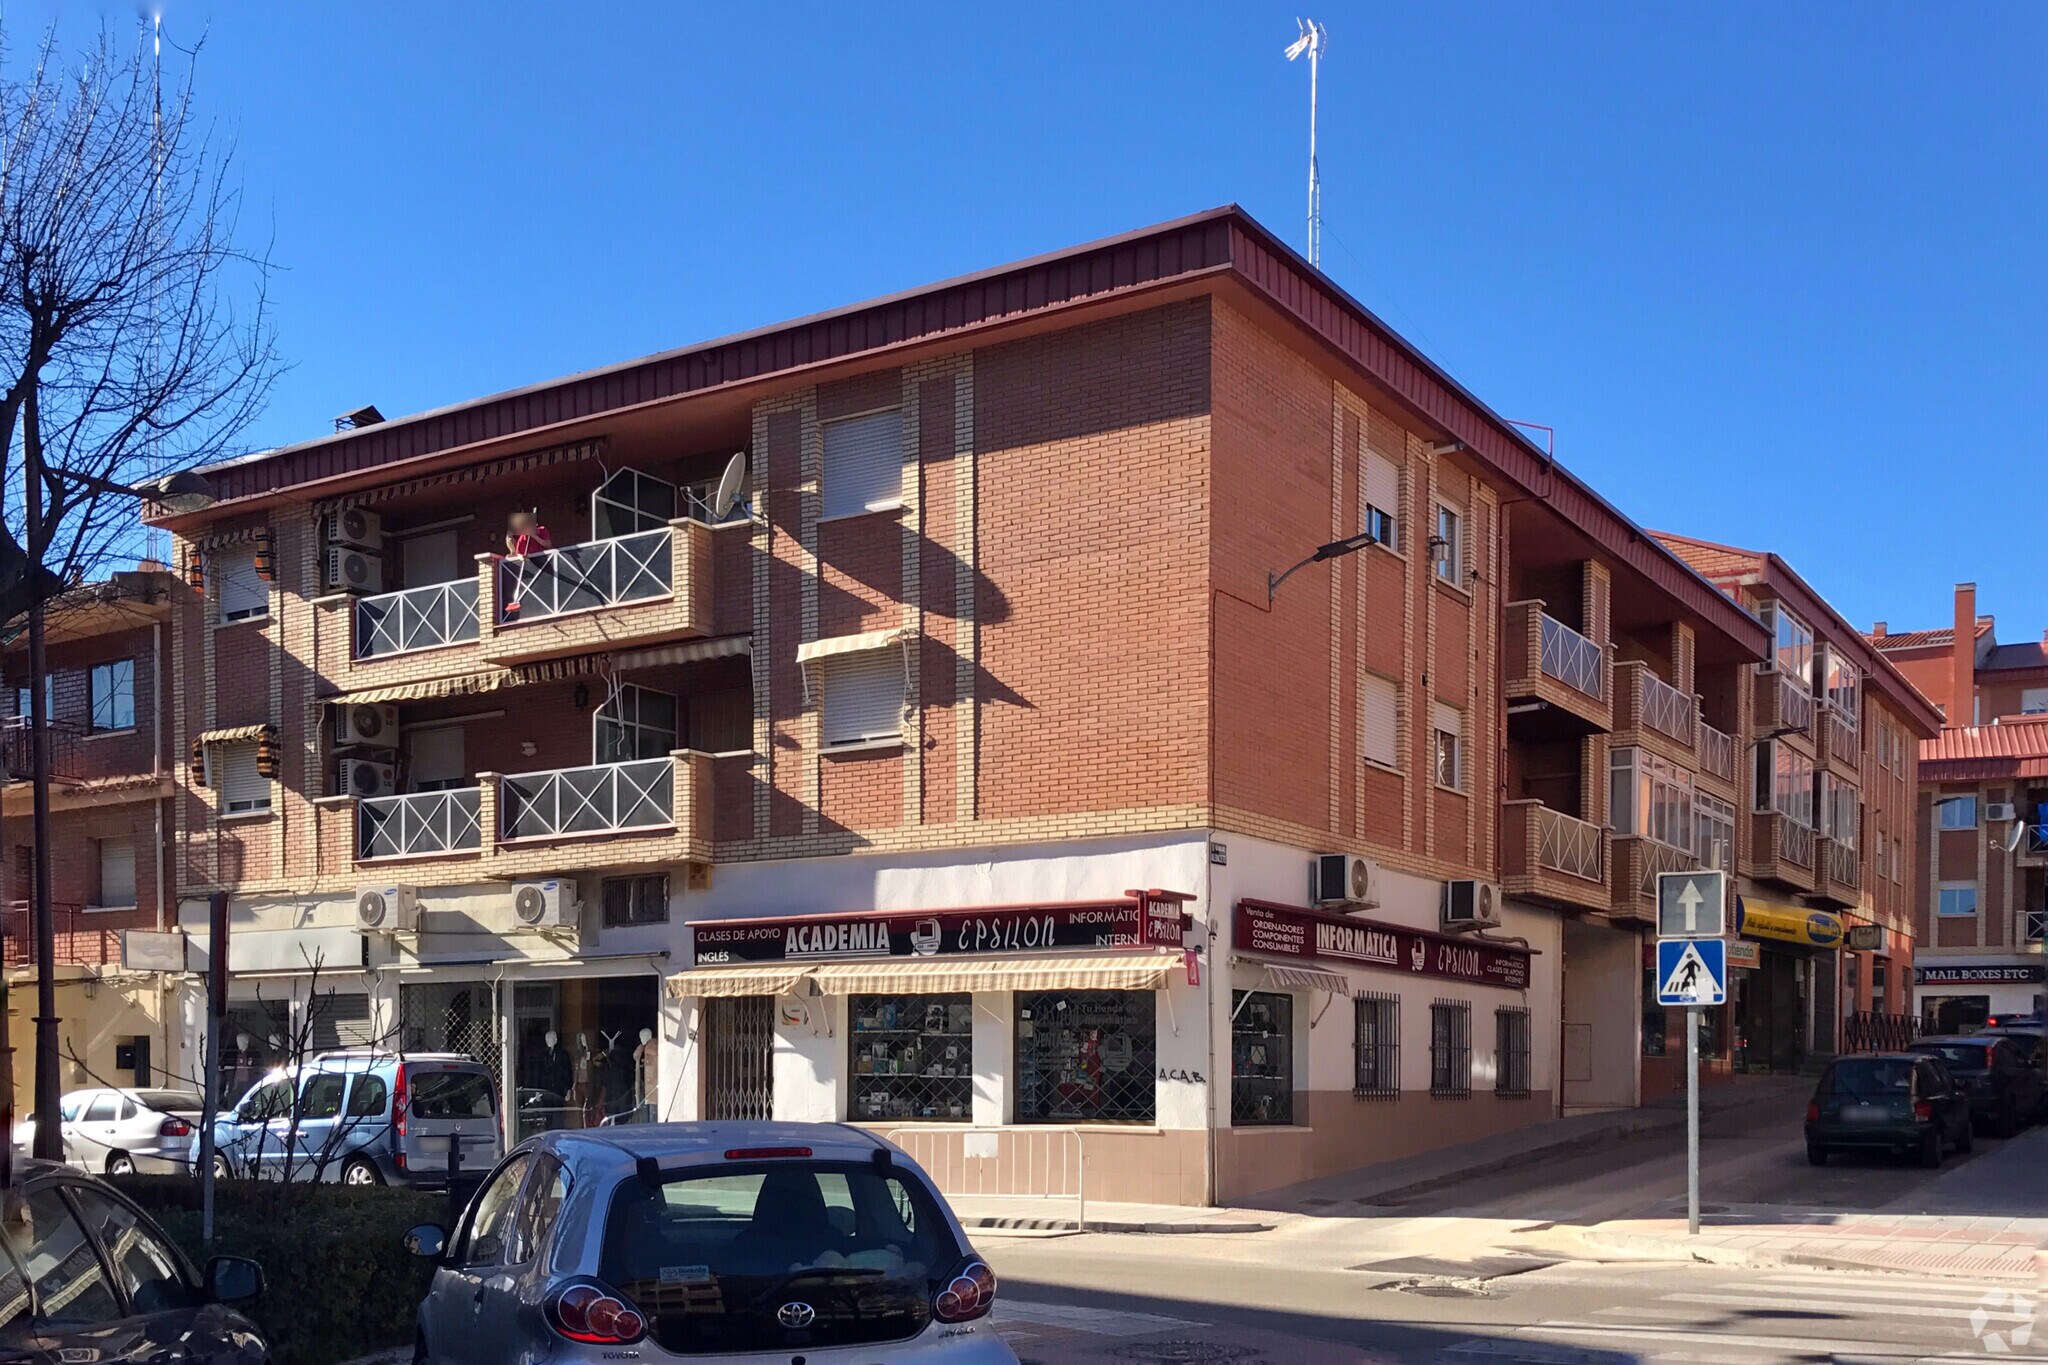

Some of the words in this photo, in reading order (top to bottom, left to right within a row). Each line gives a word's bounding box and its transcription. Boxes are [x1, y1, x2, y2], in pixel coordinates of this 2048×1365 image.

[1148, 900, 1181, 919] ACADEMIA
[1245, 906, 1264, 918] Venta
[1252, 919, 1305, 935] ORDENADORES
[697, 929, 731, 943] CLASES
[733, 929, 746, 941] DE
[748, 927, 781, 941] APOYO
[785, 922, 890, 953] ACADEMIA
[1096, 933, 1140, 946] INTERN
[1252, 929, 1305, 945] COMPONENTES
[1316, 922, 1398, 959] INFORMÁTICA
[1252, 939, 1300, 954] CONSUMIBLES
[697, 948, 730, 963] INGLÉS
[1925, 969, 1959, 980] MAIL
[1961, 969, 2001, 980] BOXES
[601, 1350, 641, 1360] TOYOTA
